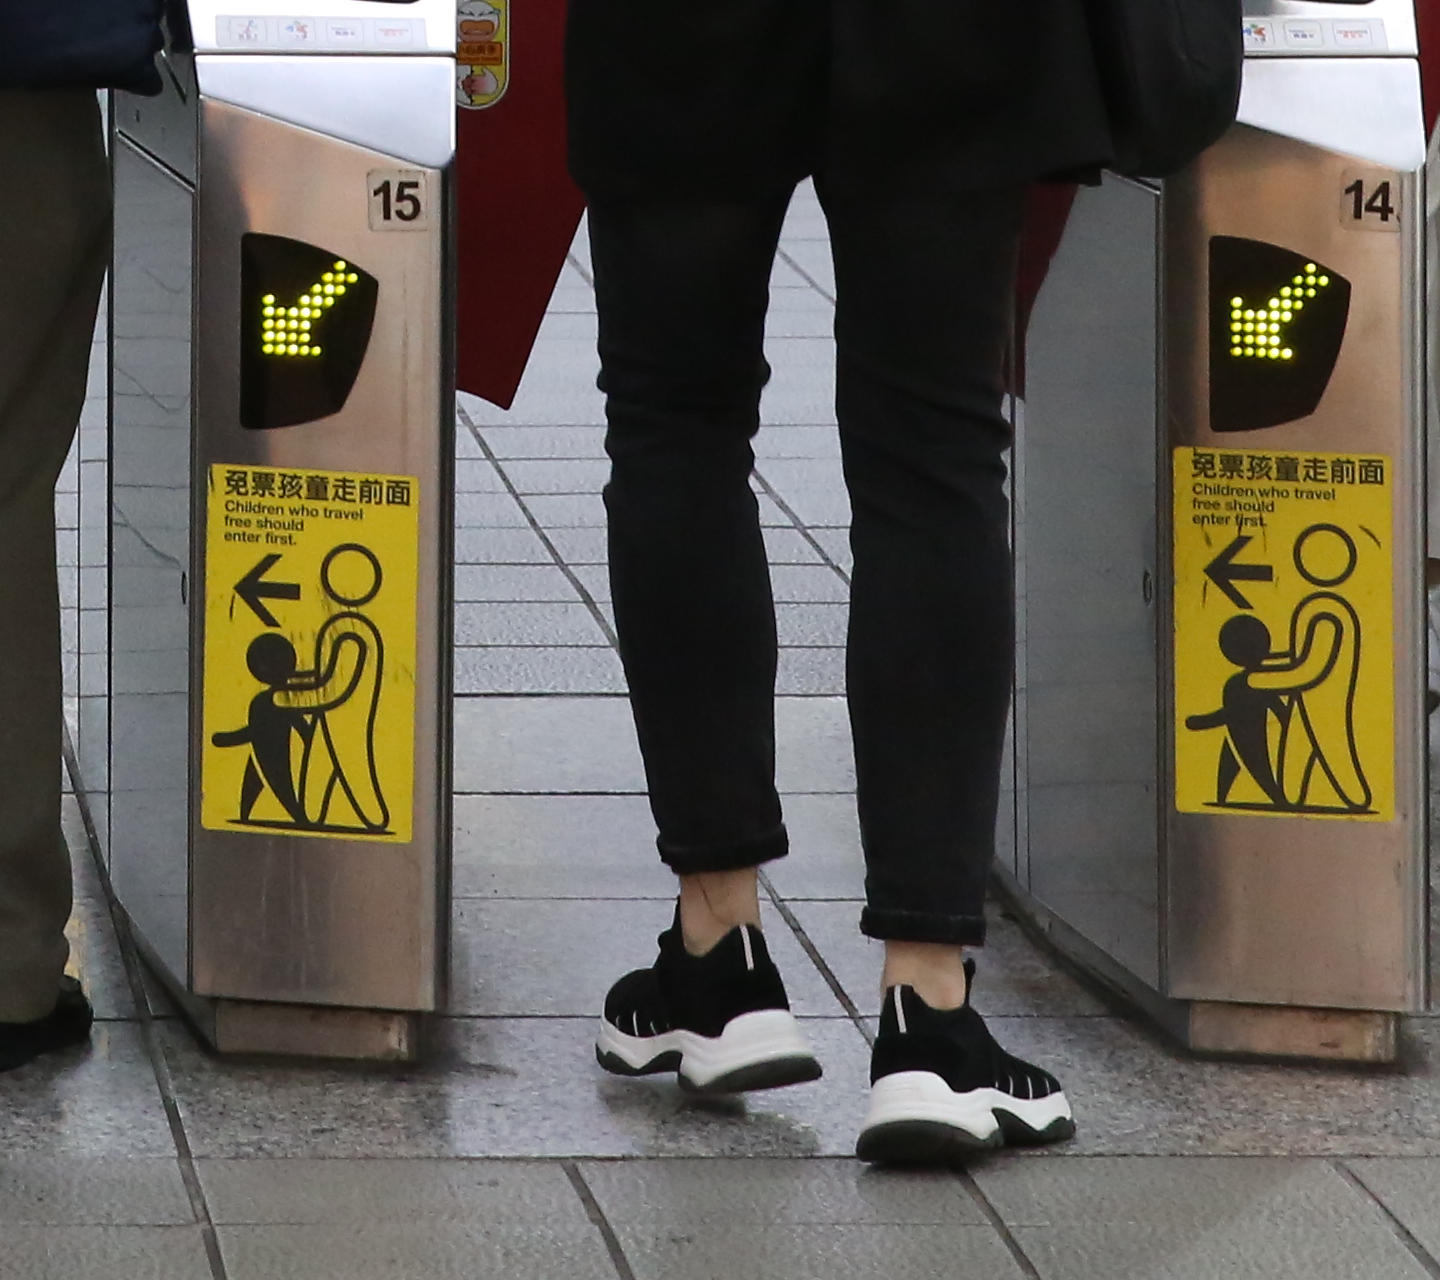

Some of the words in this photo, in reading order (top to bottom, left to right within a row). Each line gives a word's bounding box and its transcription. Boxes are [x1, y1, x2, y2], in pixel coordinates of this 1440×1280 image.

[372, 181, 421, 223] 15
[1344, 180, 1393, 222] 14
[1192, 483, 1254, 497] Children
[1258, 485, 1290, 499] who
[1294, 487, 1336, 501] travel
[225, 500, 284, 515] Children
[289, 504, 319, 518] who
[324, 507, 363, 521] travel
[1192, 499, 1221, 511] free
[1225, 500, 1275, 513] should
[225, 515, 252, 528] free
[256, 517, 304, 531] should
[1192, 513, 1231, 526] enter
[224, 531, 262, 543] enter
[266, 532, 297, 546] first.
